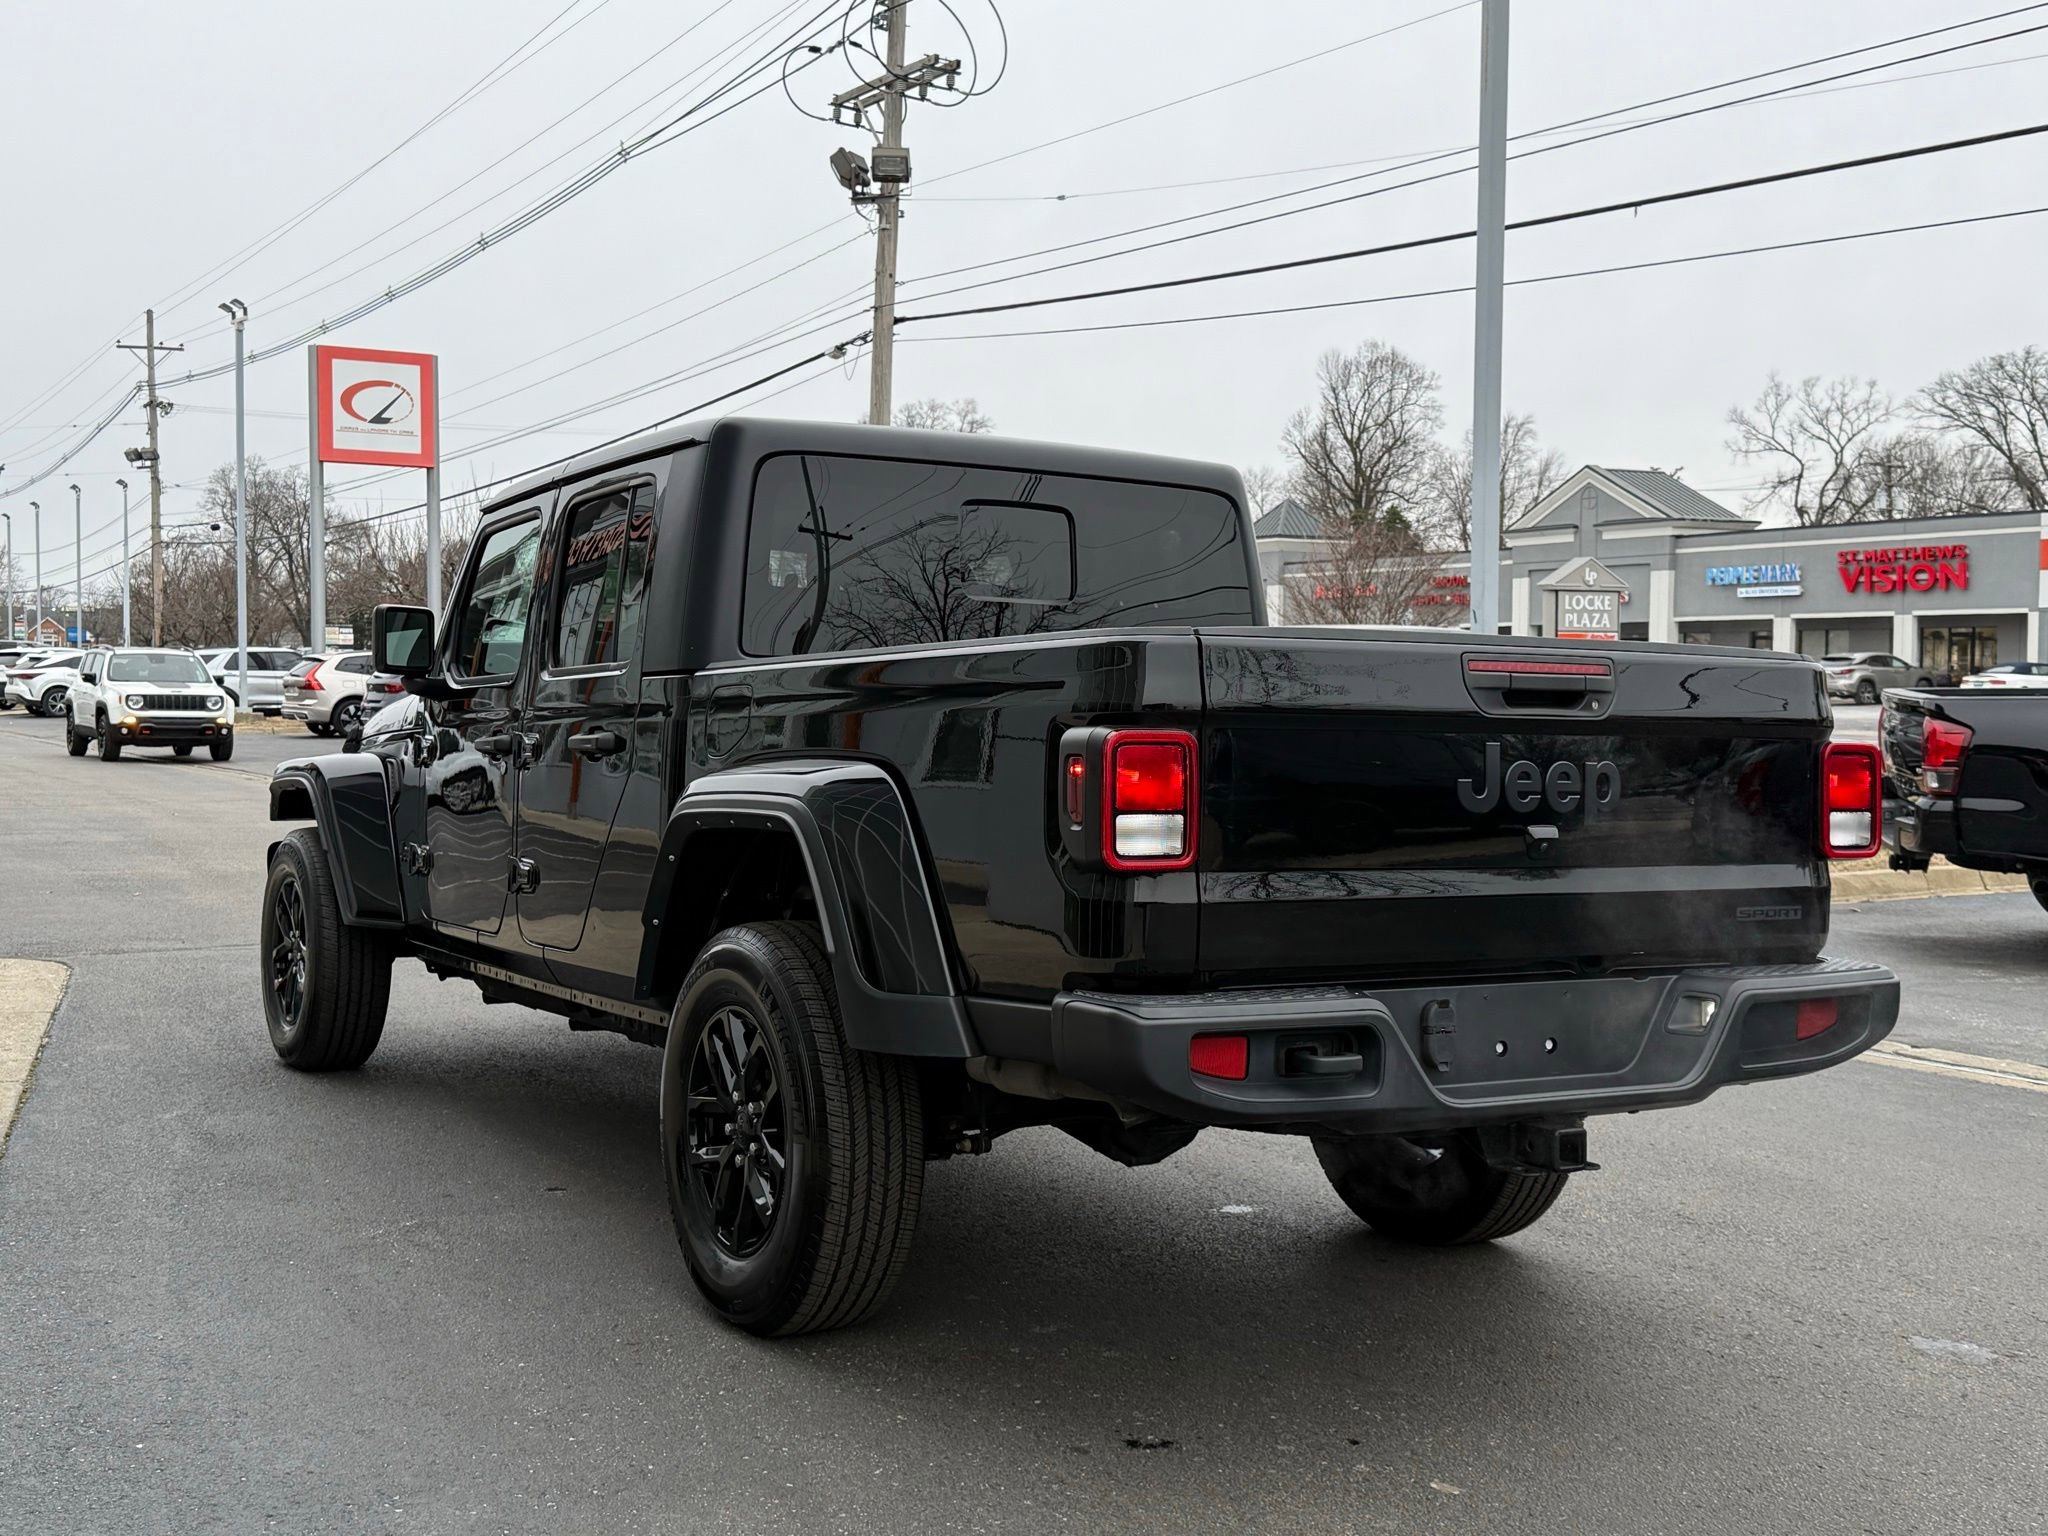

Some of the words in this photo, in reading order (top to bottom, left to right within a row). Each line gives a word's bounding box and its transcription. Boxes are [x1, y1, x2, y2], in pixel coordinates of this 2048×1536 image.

[1863, 544, 1968, 563] MATTHEWS
[1838, 561, 1968, 593] VISION
[1564, 594, 1612, 611] LOCKE
[1564, 612, 1611, 628] PLAZA
[1457, 742, 1621, 825] Jeep
[1737, 907, 1802, 919] SPORT
